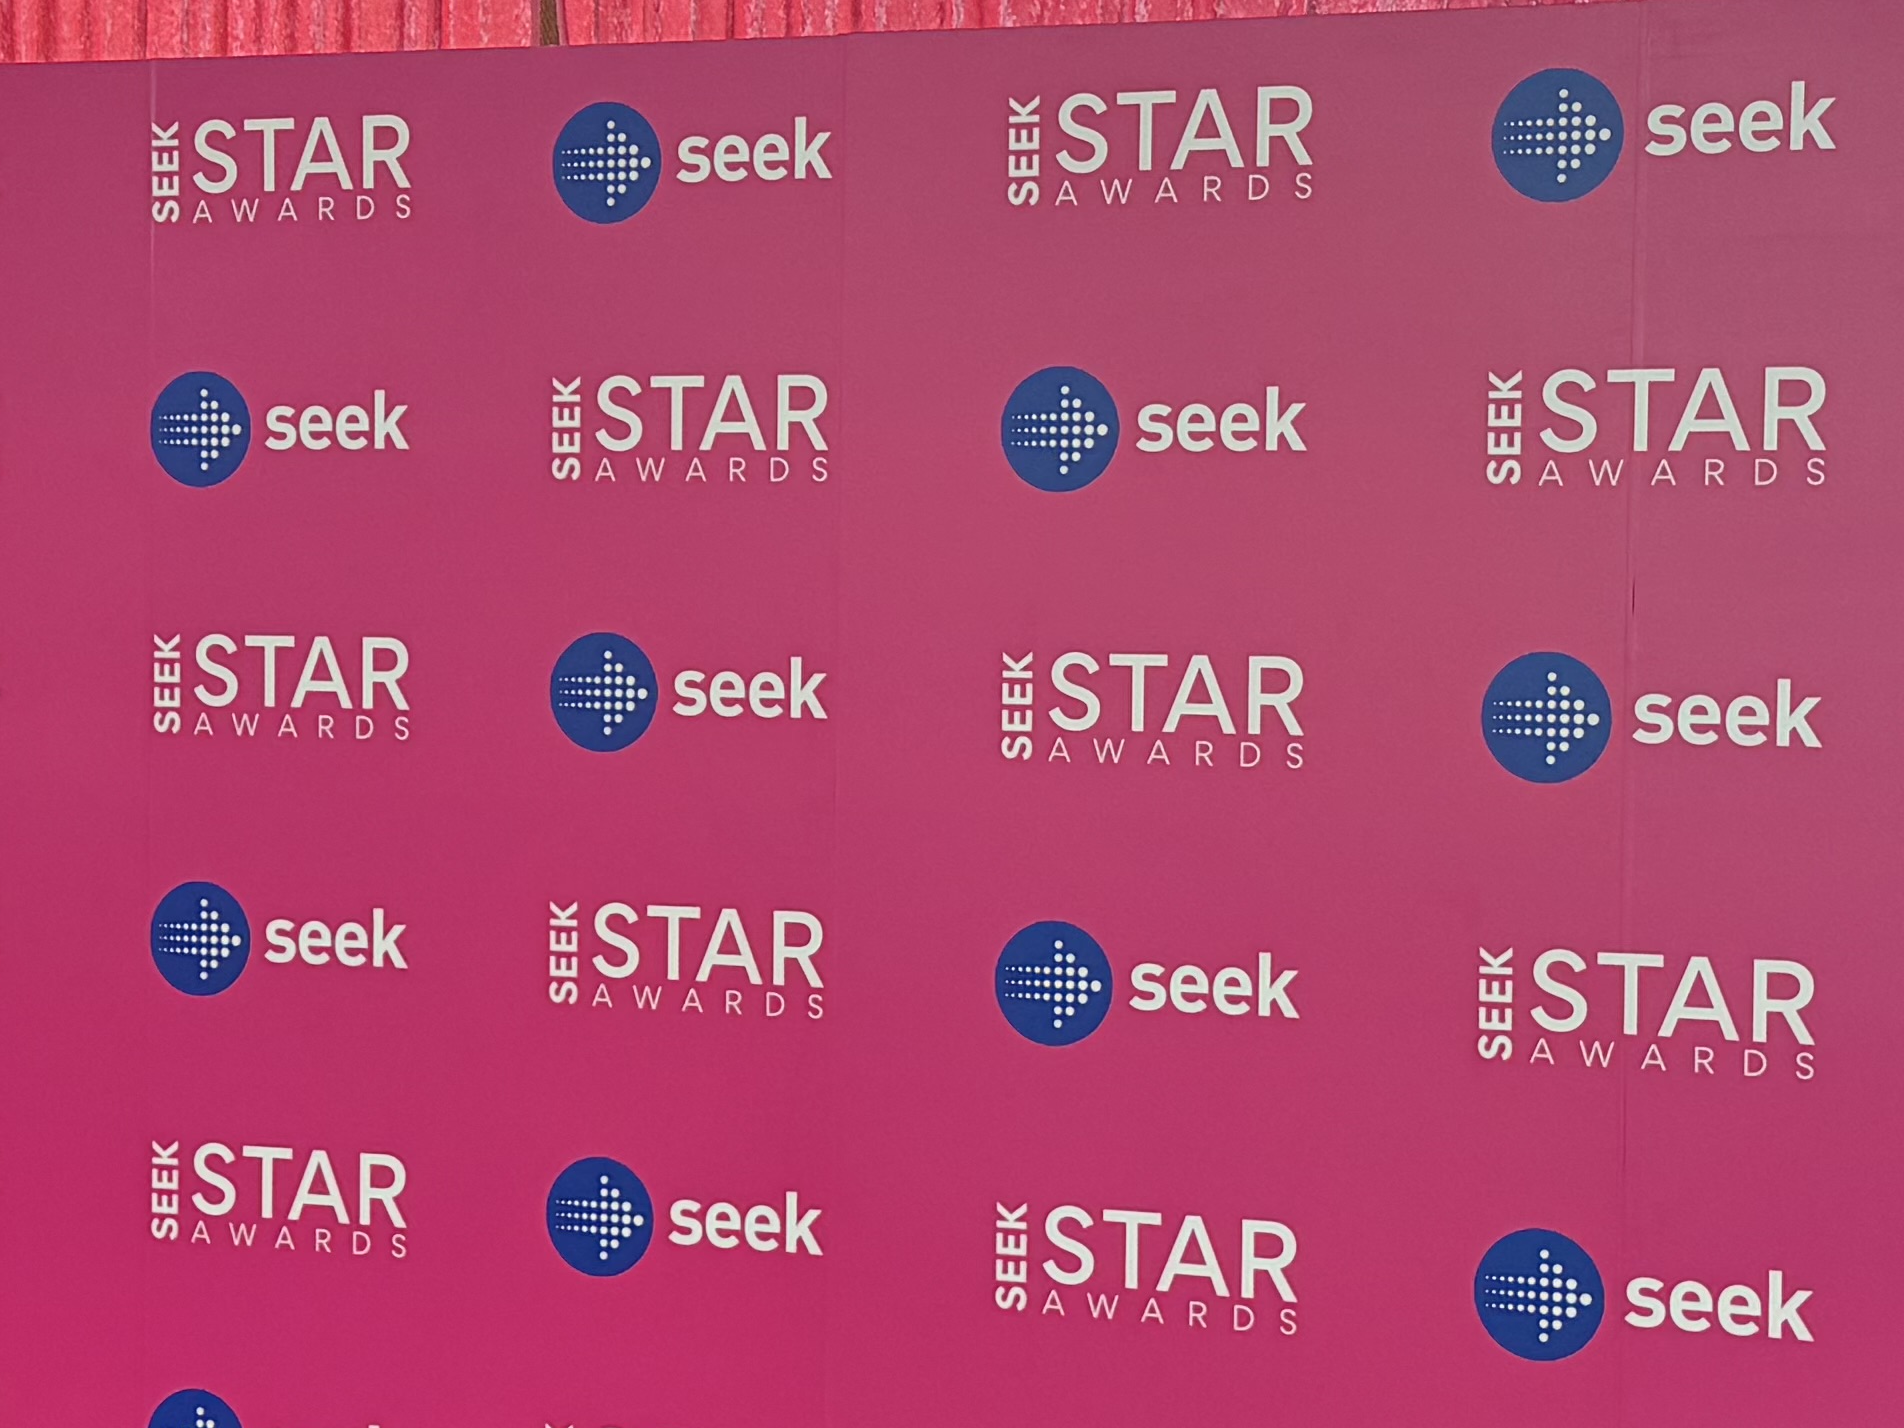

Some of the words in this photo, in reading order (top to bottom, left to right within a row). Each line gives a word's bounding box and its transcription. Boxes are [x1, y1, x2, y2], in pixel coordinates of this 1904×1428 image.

[191, 113, 413, 195] STAR
[675, 115, 834, 184] seek
[1006, 94, 1042, 207] SEEK
[1054, 84, 1314, 175] STAR
[1643, 79, 1838, 158] seek
[150, 120, 181, 224] SEEK
[191, 192, 412, 225] AWARDS
[1054, 171, 1314, 207] AWARDS
[263, 388, 411, 452] seek
[550, 375, 583, 482] SEEK
[593, 373, 830, 453] STAR
[1134, 384, 1309, 454] seek
[1485, 369, 1524, 486] SEEK
[1538, 365, 1828, 455] STAR
[593, 455, 829, 484] AWARDS
[1537, 456, 1826, 488] AWARDS
[152, 632, 183, 735] SEEK
[192, 632, 411, 712] STAR
[671, 655, 829, 721] seek
[999, 650, 1035, 762] SEEK
[1047, 650, 1306, 738] STAR
[192, 711, 411, 742] AWARDS
[1047, 735, 1305, 770] AWARDS
[1631, 677, 1824, 749] seek
[263, 906, 410, 971] seek
[547, 900, 580, 1006] SEEK
[590, 900, 826, 990] STAR
[590, 981, 825, 1021] AWARDS
[1127, 950, 1301, 1020] seek
[1476, 945, 1515, 1062] SEEK
[1529, 947, 1817, 1047] STAR
[1528, 1036, 1816, 1081] AWARDS
[149, 1139, 181, 1242] SEEK
[190, 1141, 409, 1230] STAR
[667, 1189, 825, 1257] seek
[189, 1218, 408, 1260] AWARDS
[993, 1200, 1029, 1313] SEEK
[1041, 1203, 1299, 1305] STAR
[1041, 1288, 1298, 1337] AWARDS
[1623, 1268, 1816, 1344] seek
